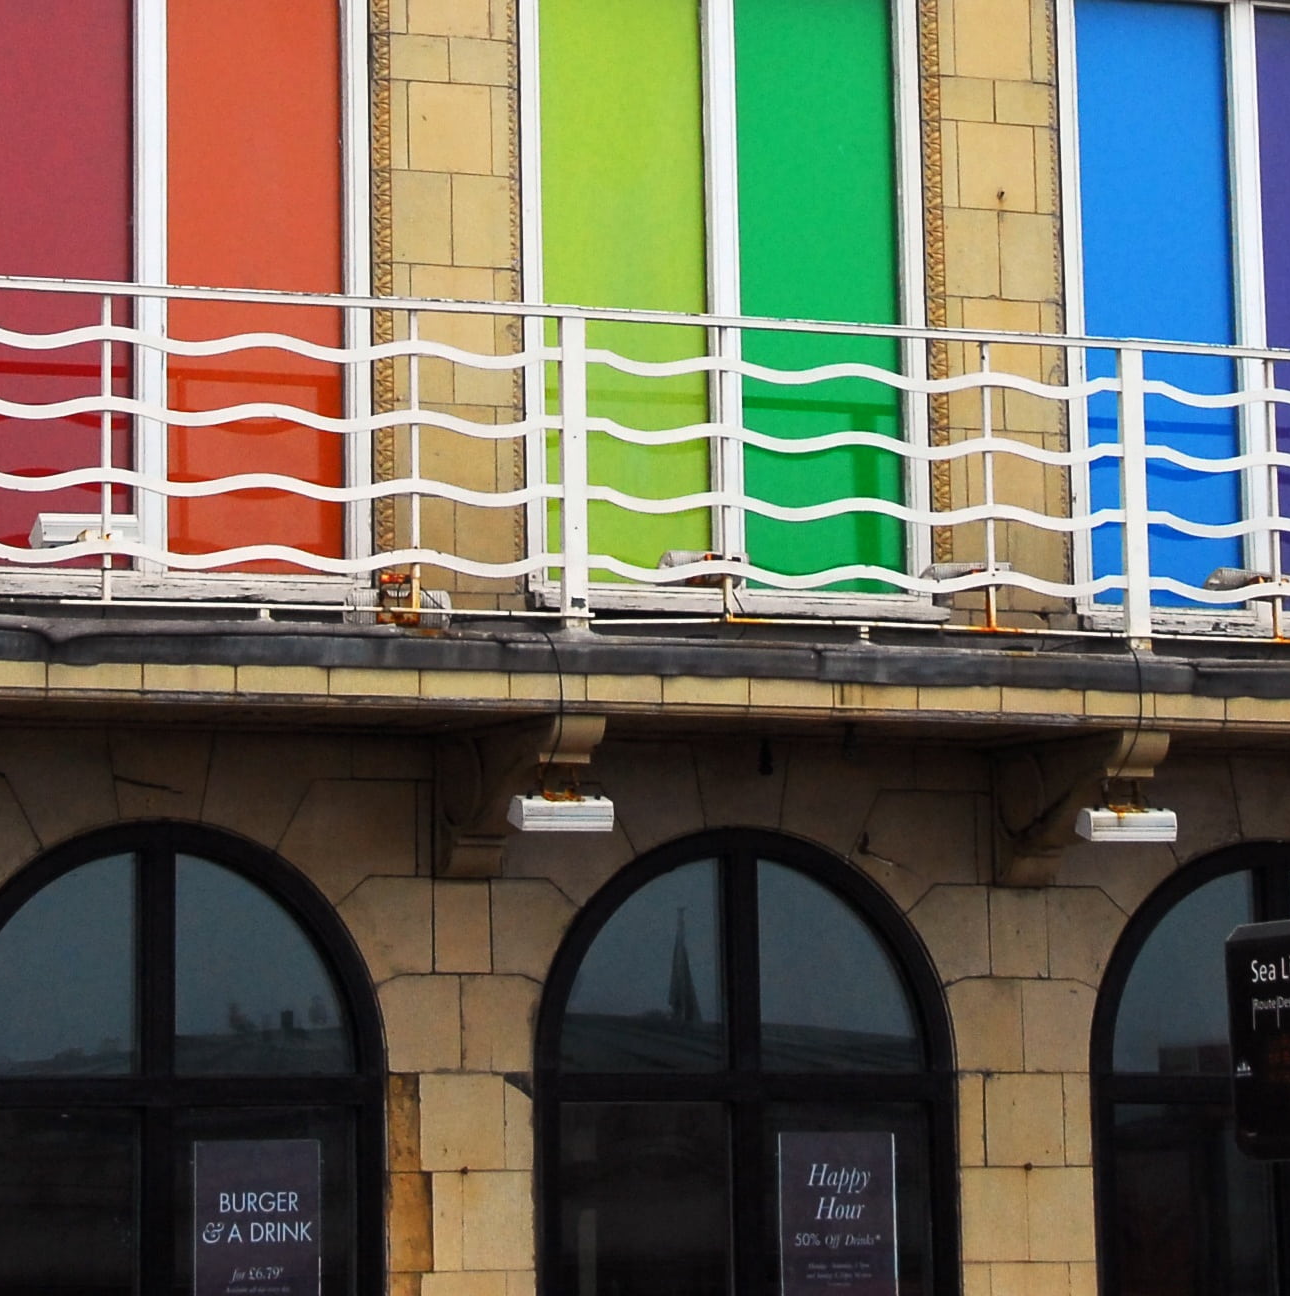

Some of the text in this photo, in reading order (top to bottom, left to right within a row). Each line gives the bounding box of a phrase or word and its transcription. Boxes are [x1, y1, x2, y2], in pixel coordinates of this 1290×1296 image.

[1251, 959, 1276, 983] Sea
[1254, 997, 1276, 1010] Route
[807, 1163, 871, 1194] Happy
[219, 1191, 299, 1213] BURGER
[815, 1196, 865, 1220] Hour
[202, 1221, 313, 1244] & A DRINK
[794, 1232, 821, 1247] 50%
[825, 1233, 841, 1249] Off
